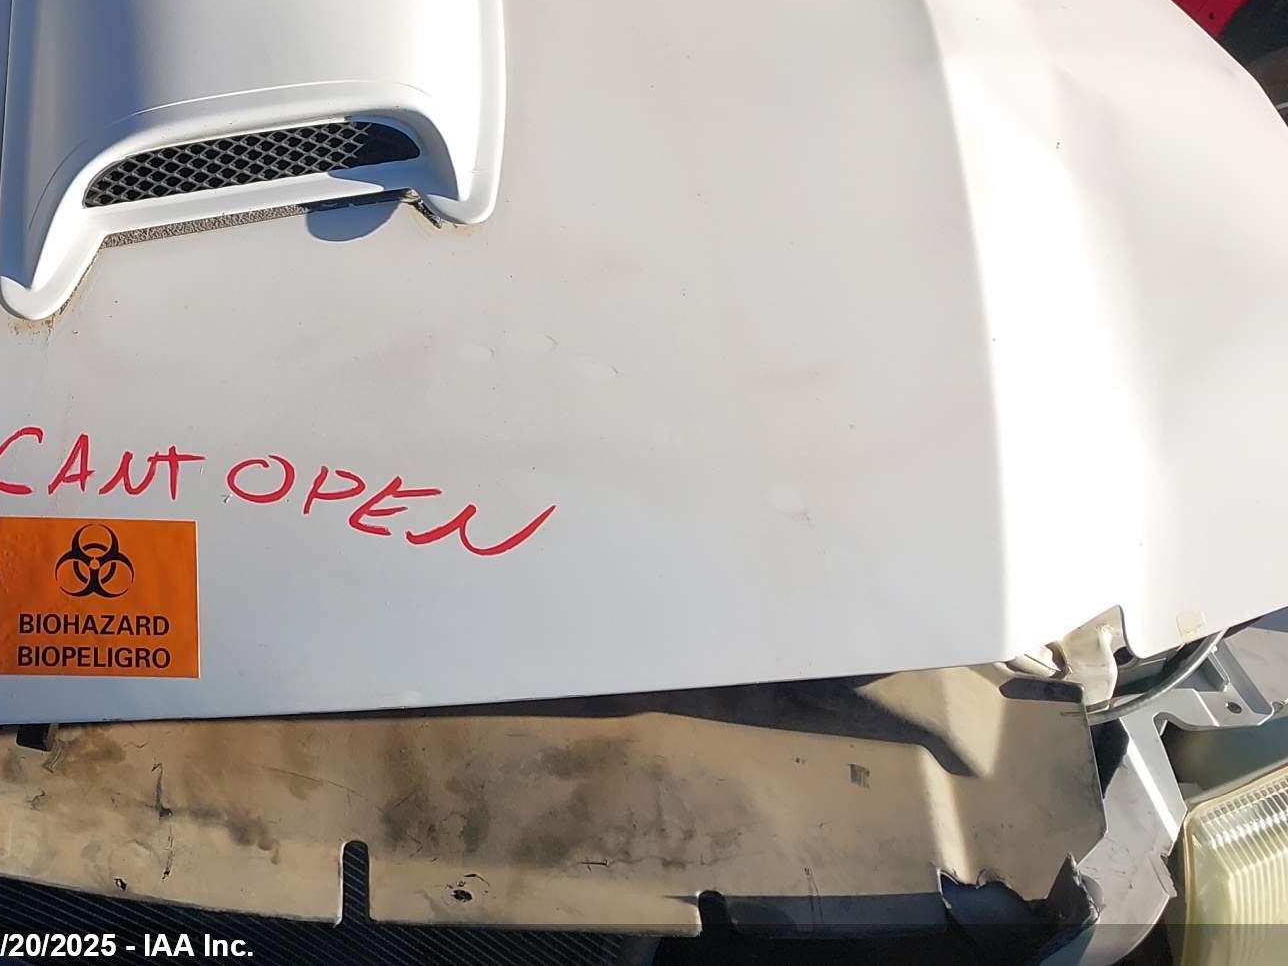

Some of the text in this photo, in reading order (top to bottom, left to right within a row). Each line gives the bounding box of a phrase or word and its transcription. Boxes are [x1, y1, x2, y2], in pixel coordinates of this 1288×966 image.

[226, 454, 557, 557] OPEN
[17, 612, 170, 637] BIOHAZARD
[16, 644, 172, 670] BIOPELIGRO
